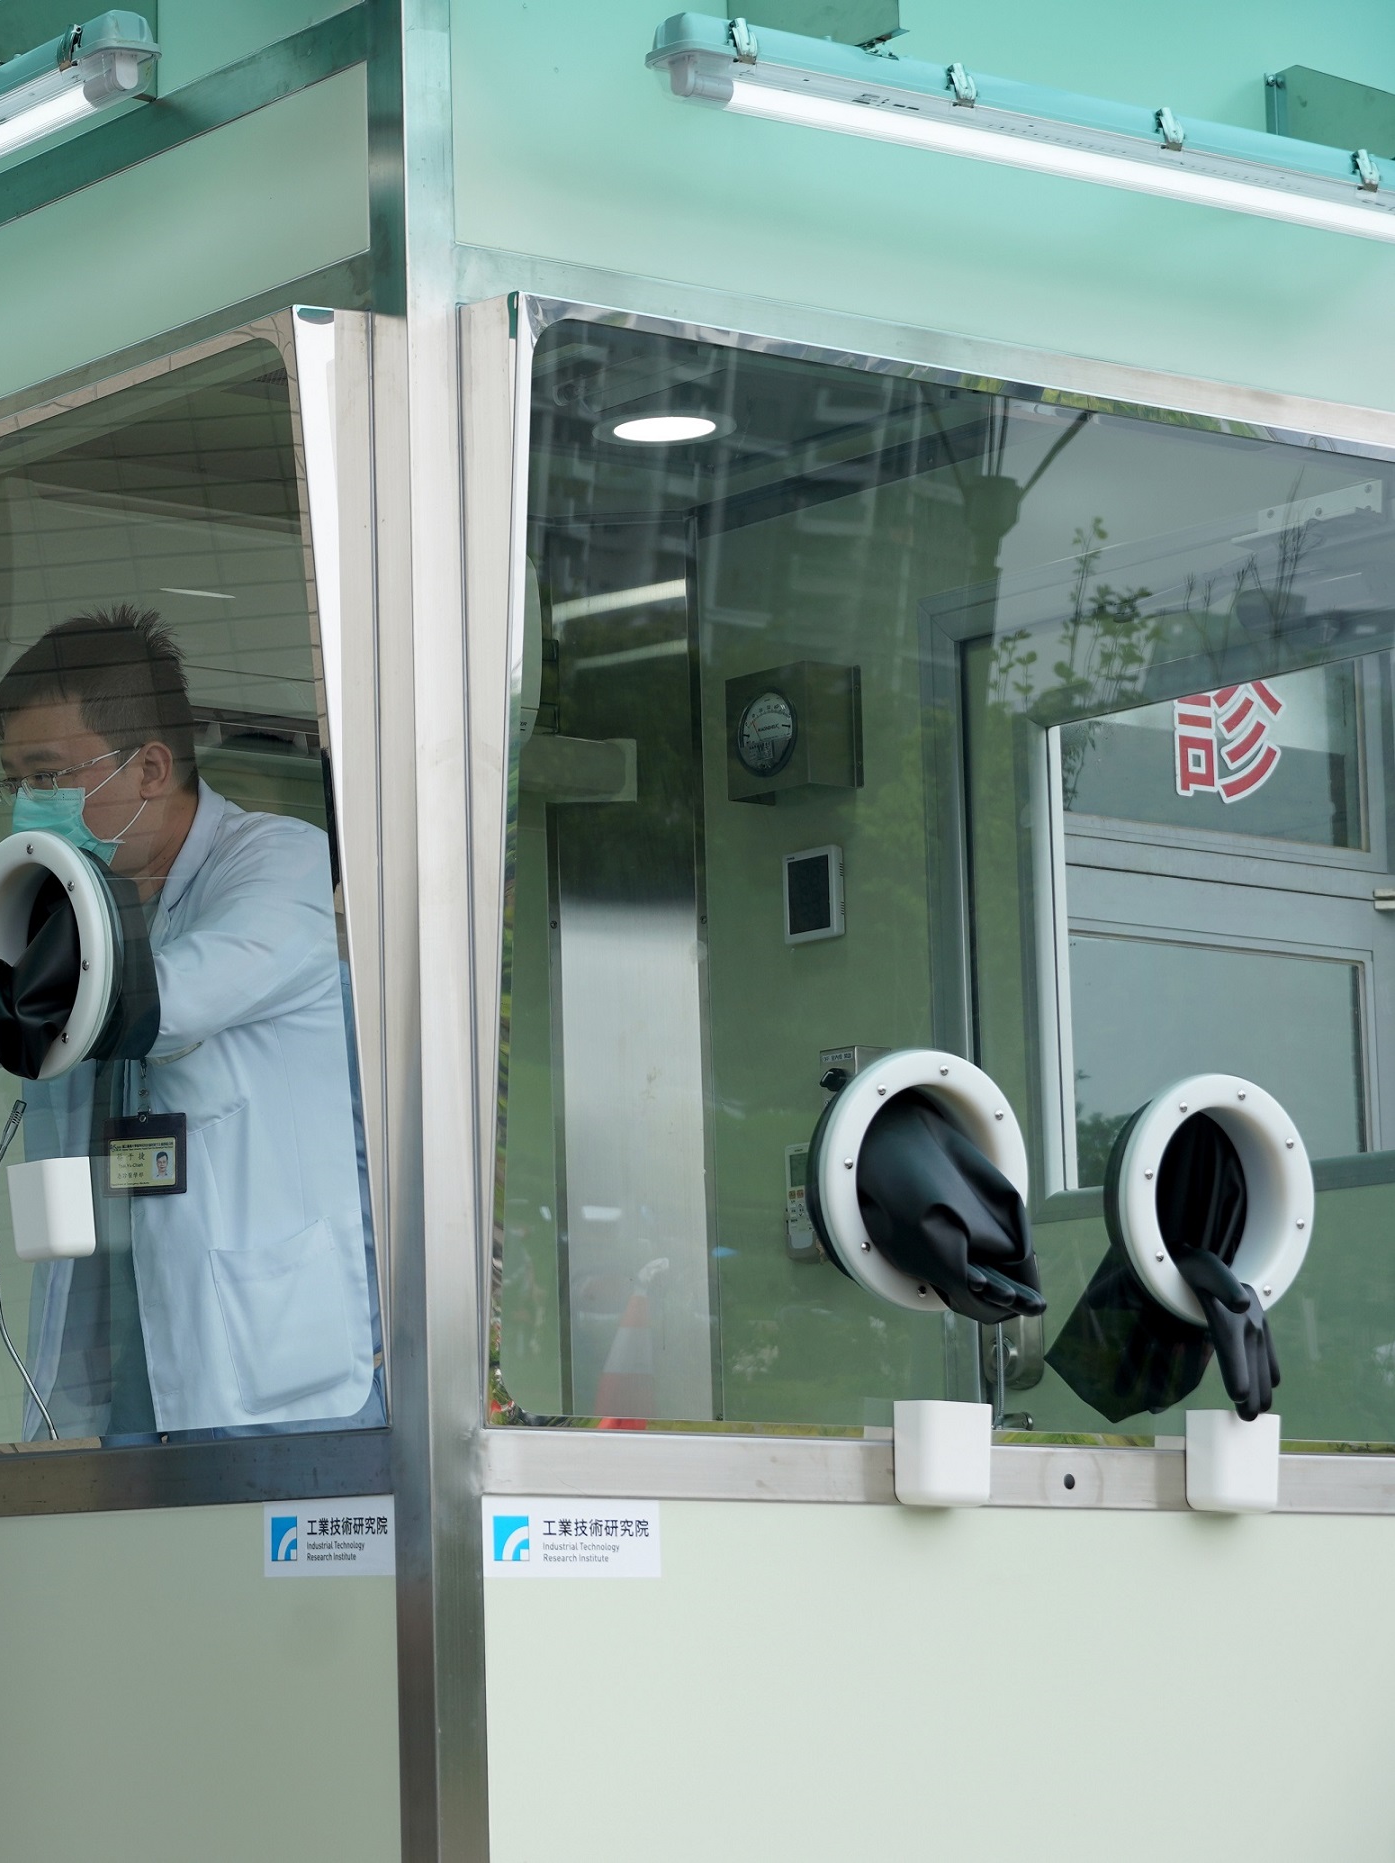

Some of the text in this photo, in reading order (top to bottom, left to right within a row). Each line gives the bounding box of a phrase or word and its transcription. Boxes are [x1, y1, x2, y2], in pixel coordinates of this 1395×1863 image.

[1175, 680, 1284, 801] 診
[306, 1516, 388, 1536] 工業技術研究院
[542, 1519, 650, 1537] 工業技術研究院
[306, 1540, 365, 1551] Industrial Technology
[542, 1542, 620, 1552] Industrial Technology
[306, 1552, 357, 1561] Research Institute
[542, 1553, 609, 1562] Research Institute
